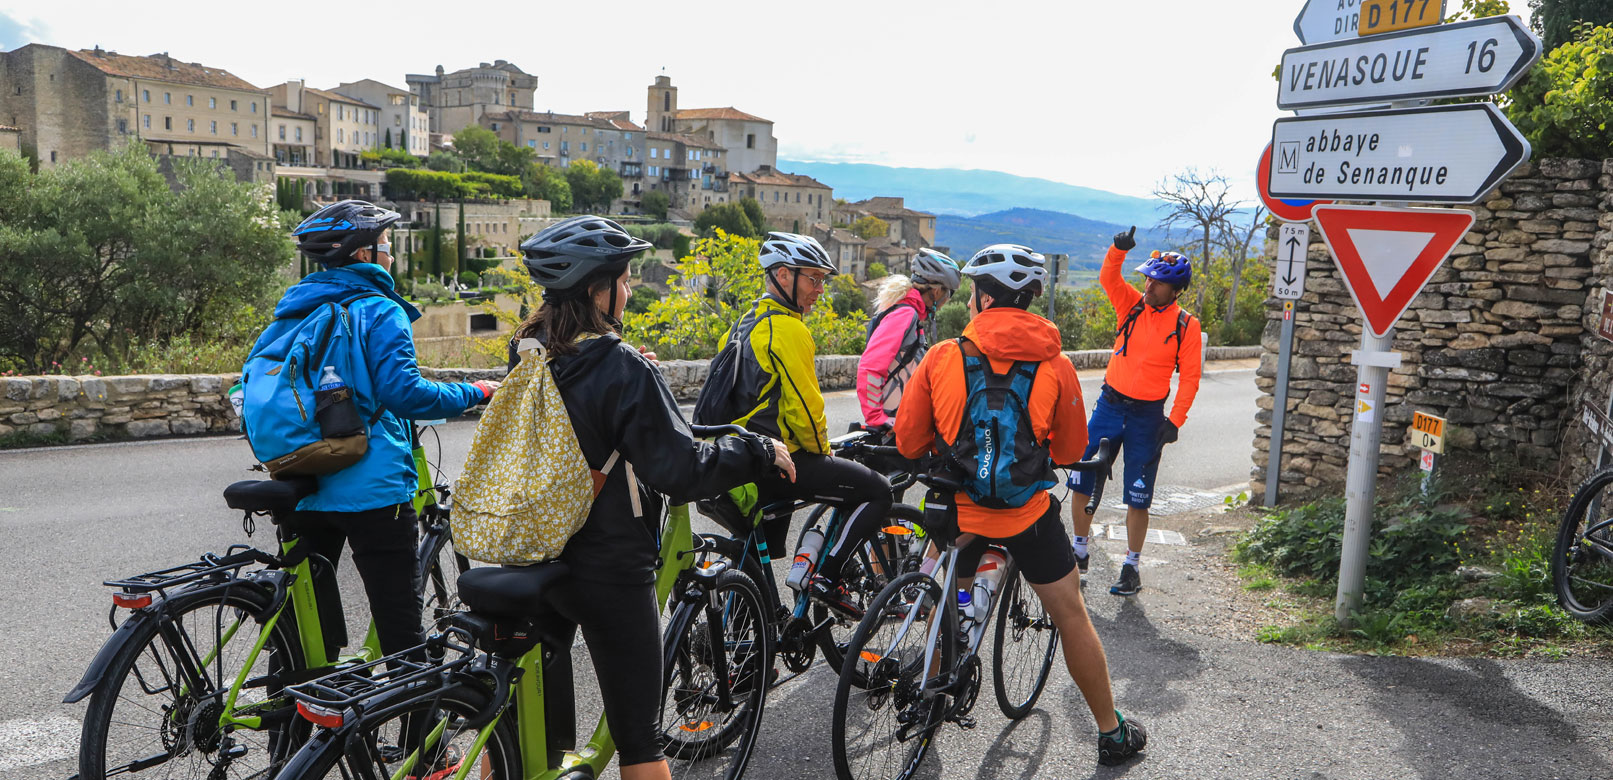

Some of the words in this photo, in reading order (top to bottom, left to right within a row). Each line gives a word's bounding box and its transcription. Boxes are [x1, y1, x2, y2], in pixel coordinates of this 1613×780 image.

[1368, 4, 1380, 28] D
[1389, 0, 1429, 25] 177
[1290, 47, 1429, 91] VENASQUE
[1464, 38, 1498, 74] 16
[1306, 129, 1379, 156] abbaye
[1303, 162, 1324, 184] de
[1336, 161, 1448, 191] Senanque
[1416, 414, 1440, 434] D177
[979, 428, 993, 479] Quechua
[1422, 433, 1429, 448] 0
